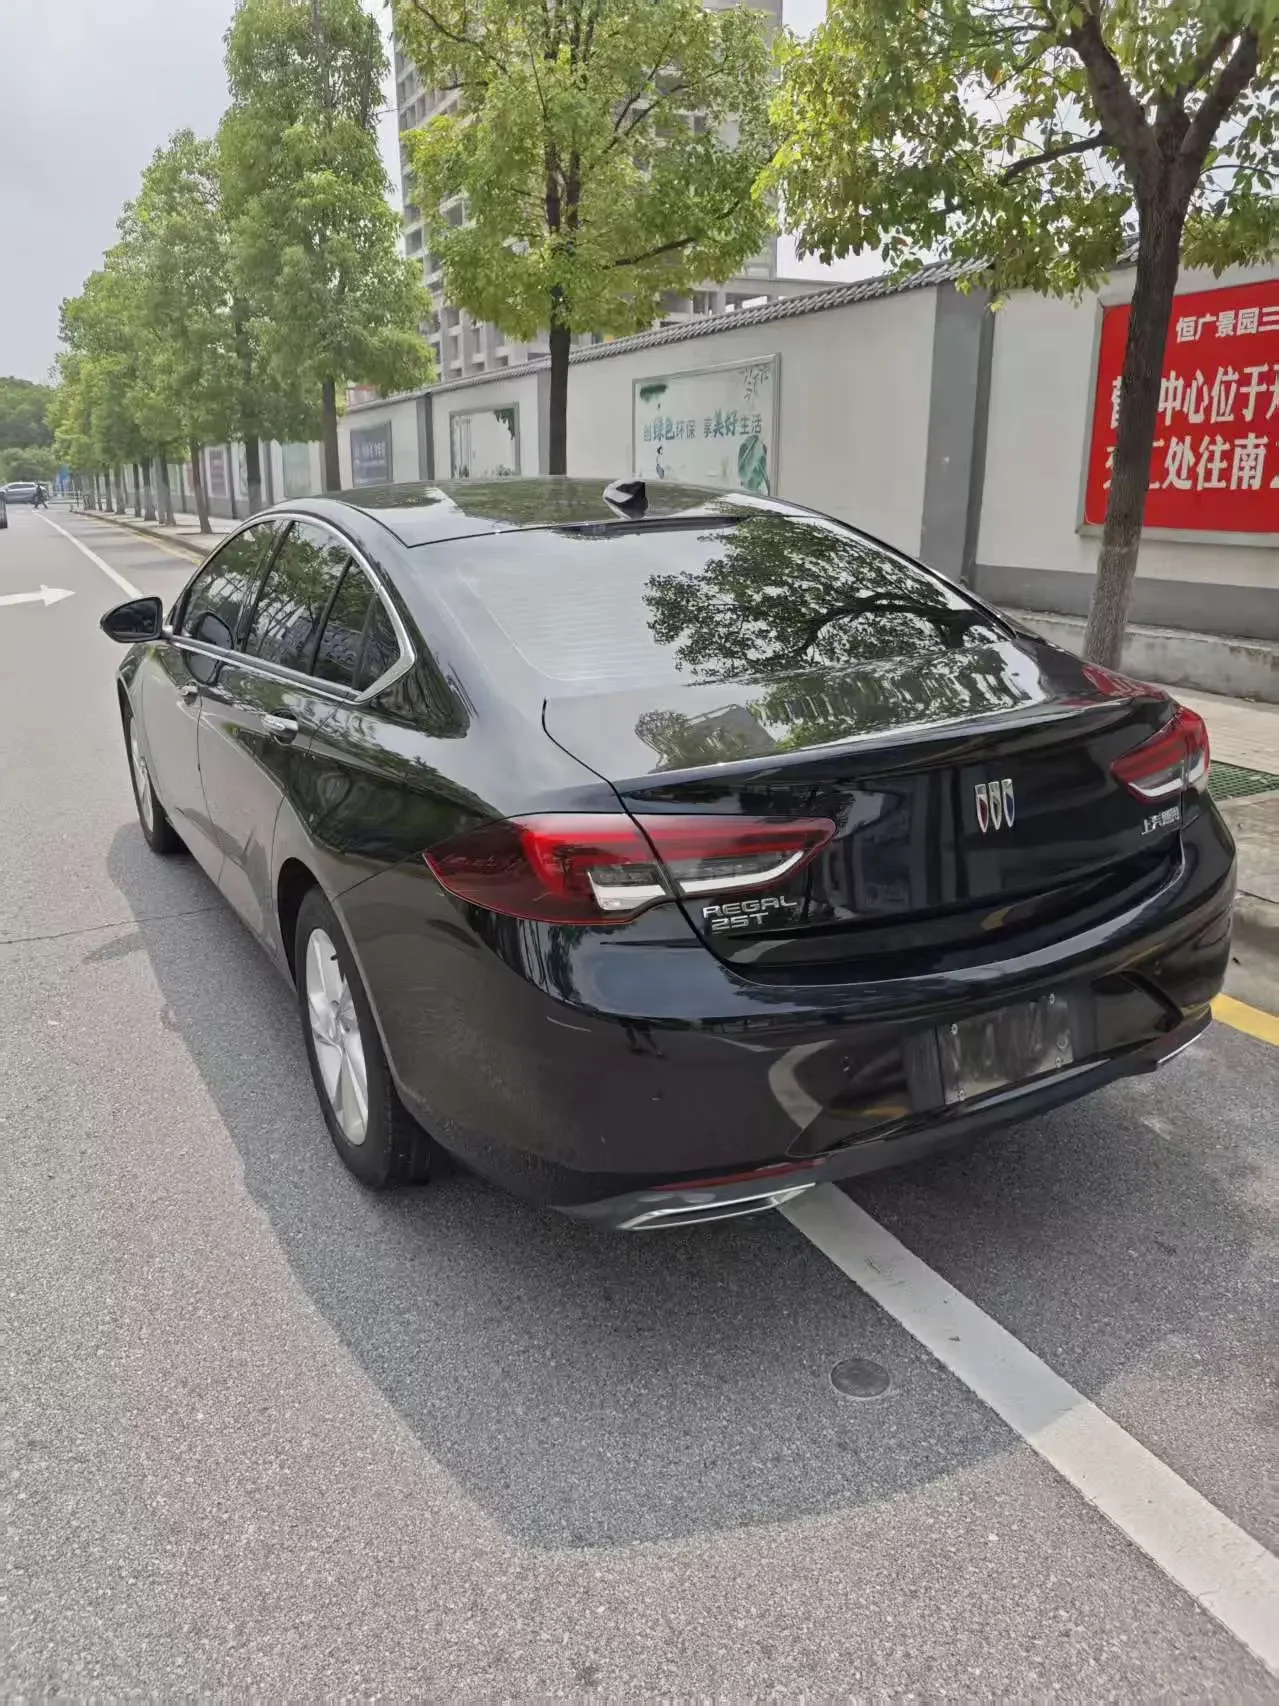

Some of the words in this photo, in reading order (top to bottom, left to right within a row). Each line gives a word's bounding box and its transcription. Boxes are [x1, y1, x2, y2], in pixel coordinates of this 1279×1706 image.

[1111, 363, 1279, 429] 中心位于
[703, 408, 763, 440] 享美好生活
[702, 896, 798, 918] REGAL
[711, 912, 769, 931] 25T
